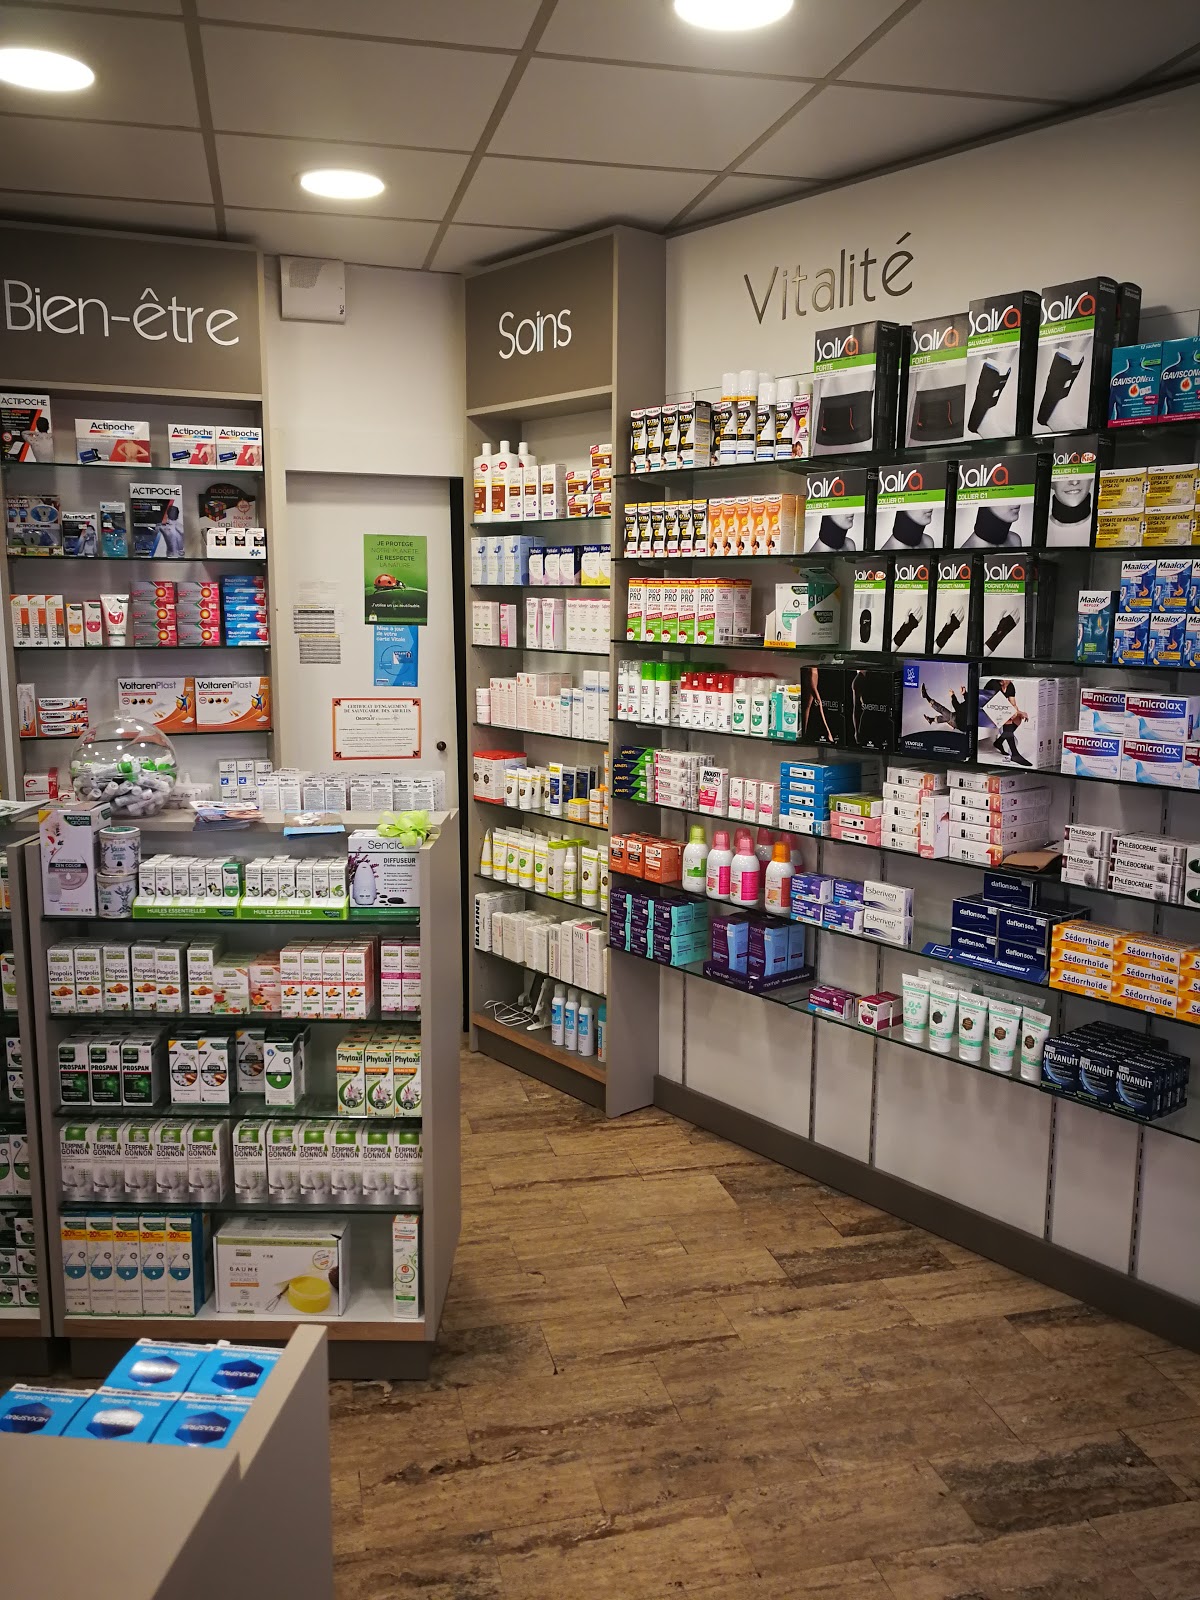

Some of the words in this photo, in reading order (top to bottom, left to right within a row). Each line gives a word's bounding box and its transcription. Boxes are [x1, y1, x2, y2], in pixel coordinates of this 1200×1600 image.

[744, 232, 914, 325] Vitalité
[4, 279, 240, 346] Bien-être
[1041, 291, 1096, 326] Salva
[969, 304, 1021, 337] Salva
[499, 309, 572, 360] Soins
[913, 325, 959, 355] Salva
[912, 355, 931, 366] FORTE
[816, 363, 834, 373] FORTE
[1, 397, 47, 407] ACTIPOCHE
[91, 422, 135, 433] Actipoche
[173, 427, 213, 438] Actipoche
[219, 429, 259, 440] Actipoche
[879, 469, 923, 496] Salva
[959, 463, 1009, 491] Salva
[132, 487, 180, 497] ACTIPOCHE
[807, 477, 845, 501] Salva
[878, 497, 896, 505] COLLIER
[897, 496, 905, 504] C1
[957, 493, 978, 501] COLLIER
[979, 492, 988, 500] C1
[805, 502, 823, 511] COLLIER
[1123, 562, 1154, 572] Maalox
[1158, 561, 1189, 571] Maalox
[895, 563, 929, 581] Salva
[938, 563, 971, 581] Salva
[984, 563, 1025, 582] Salva
[629, 592, 642, 601] PRO
[680, 594, 694, 603] PRO
[700, 593, 714, 602] PRO
[1079, 595, 1109, 605] Maalox
[1116, 614, 1146, 625] Maalox
[1151, 614, 1182, 624] Maalox
[1139, 697, 1182, 711] microlax
[1076, 736, 1116, 750] microlax
[1136, 742, 1178, 757] microlax
[1065, 932, 1110, 950] Sédorrhoïde
[1127, 945, 1175, 964] Sédorrhoïde
[1063, 953, 1109, 971] Sédorrhoïde
[49, 970, 72, 978] Propolis
[76, 970, 99, 978] Propolis
[106, 967, 128, 975] Propolis
[1062, 973, 1108, 991] Sédorrhoïde
[338, 1053, 363, 1063] Phytoxil
[366, 1055, 392, 1065] Phytoxil
[395, 1055, 420, 1065] Phytoxil
[1116, 1071, 1153, 1090] NOVANUIT
[125, 1143, 148, 1151] TERPINE
[217, 1369, 260, 1380] HEXASPRAY
[5, 1414, 48, 1424] HEXASPRAY
[181, 1424, 226, 1434] HEXASPRAY
